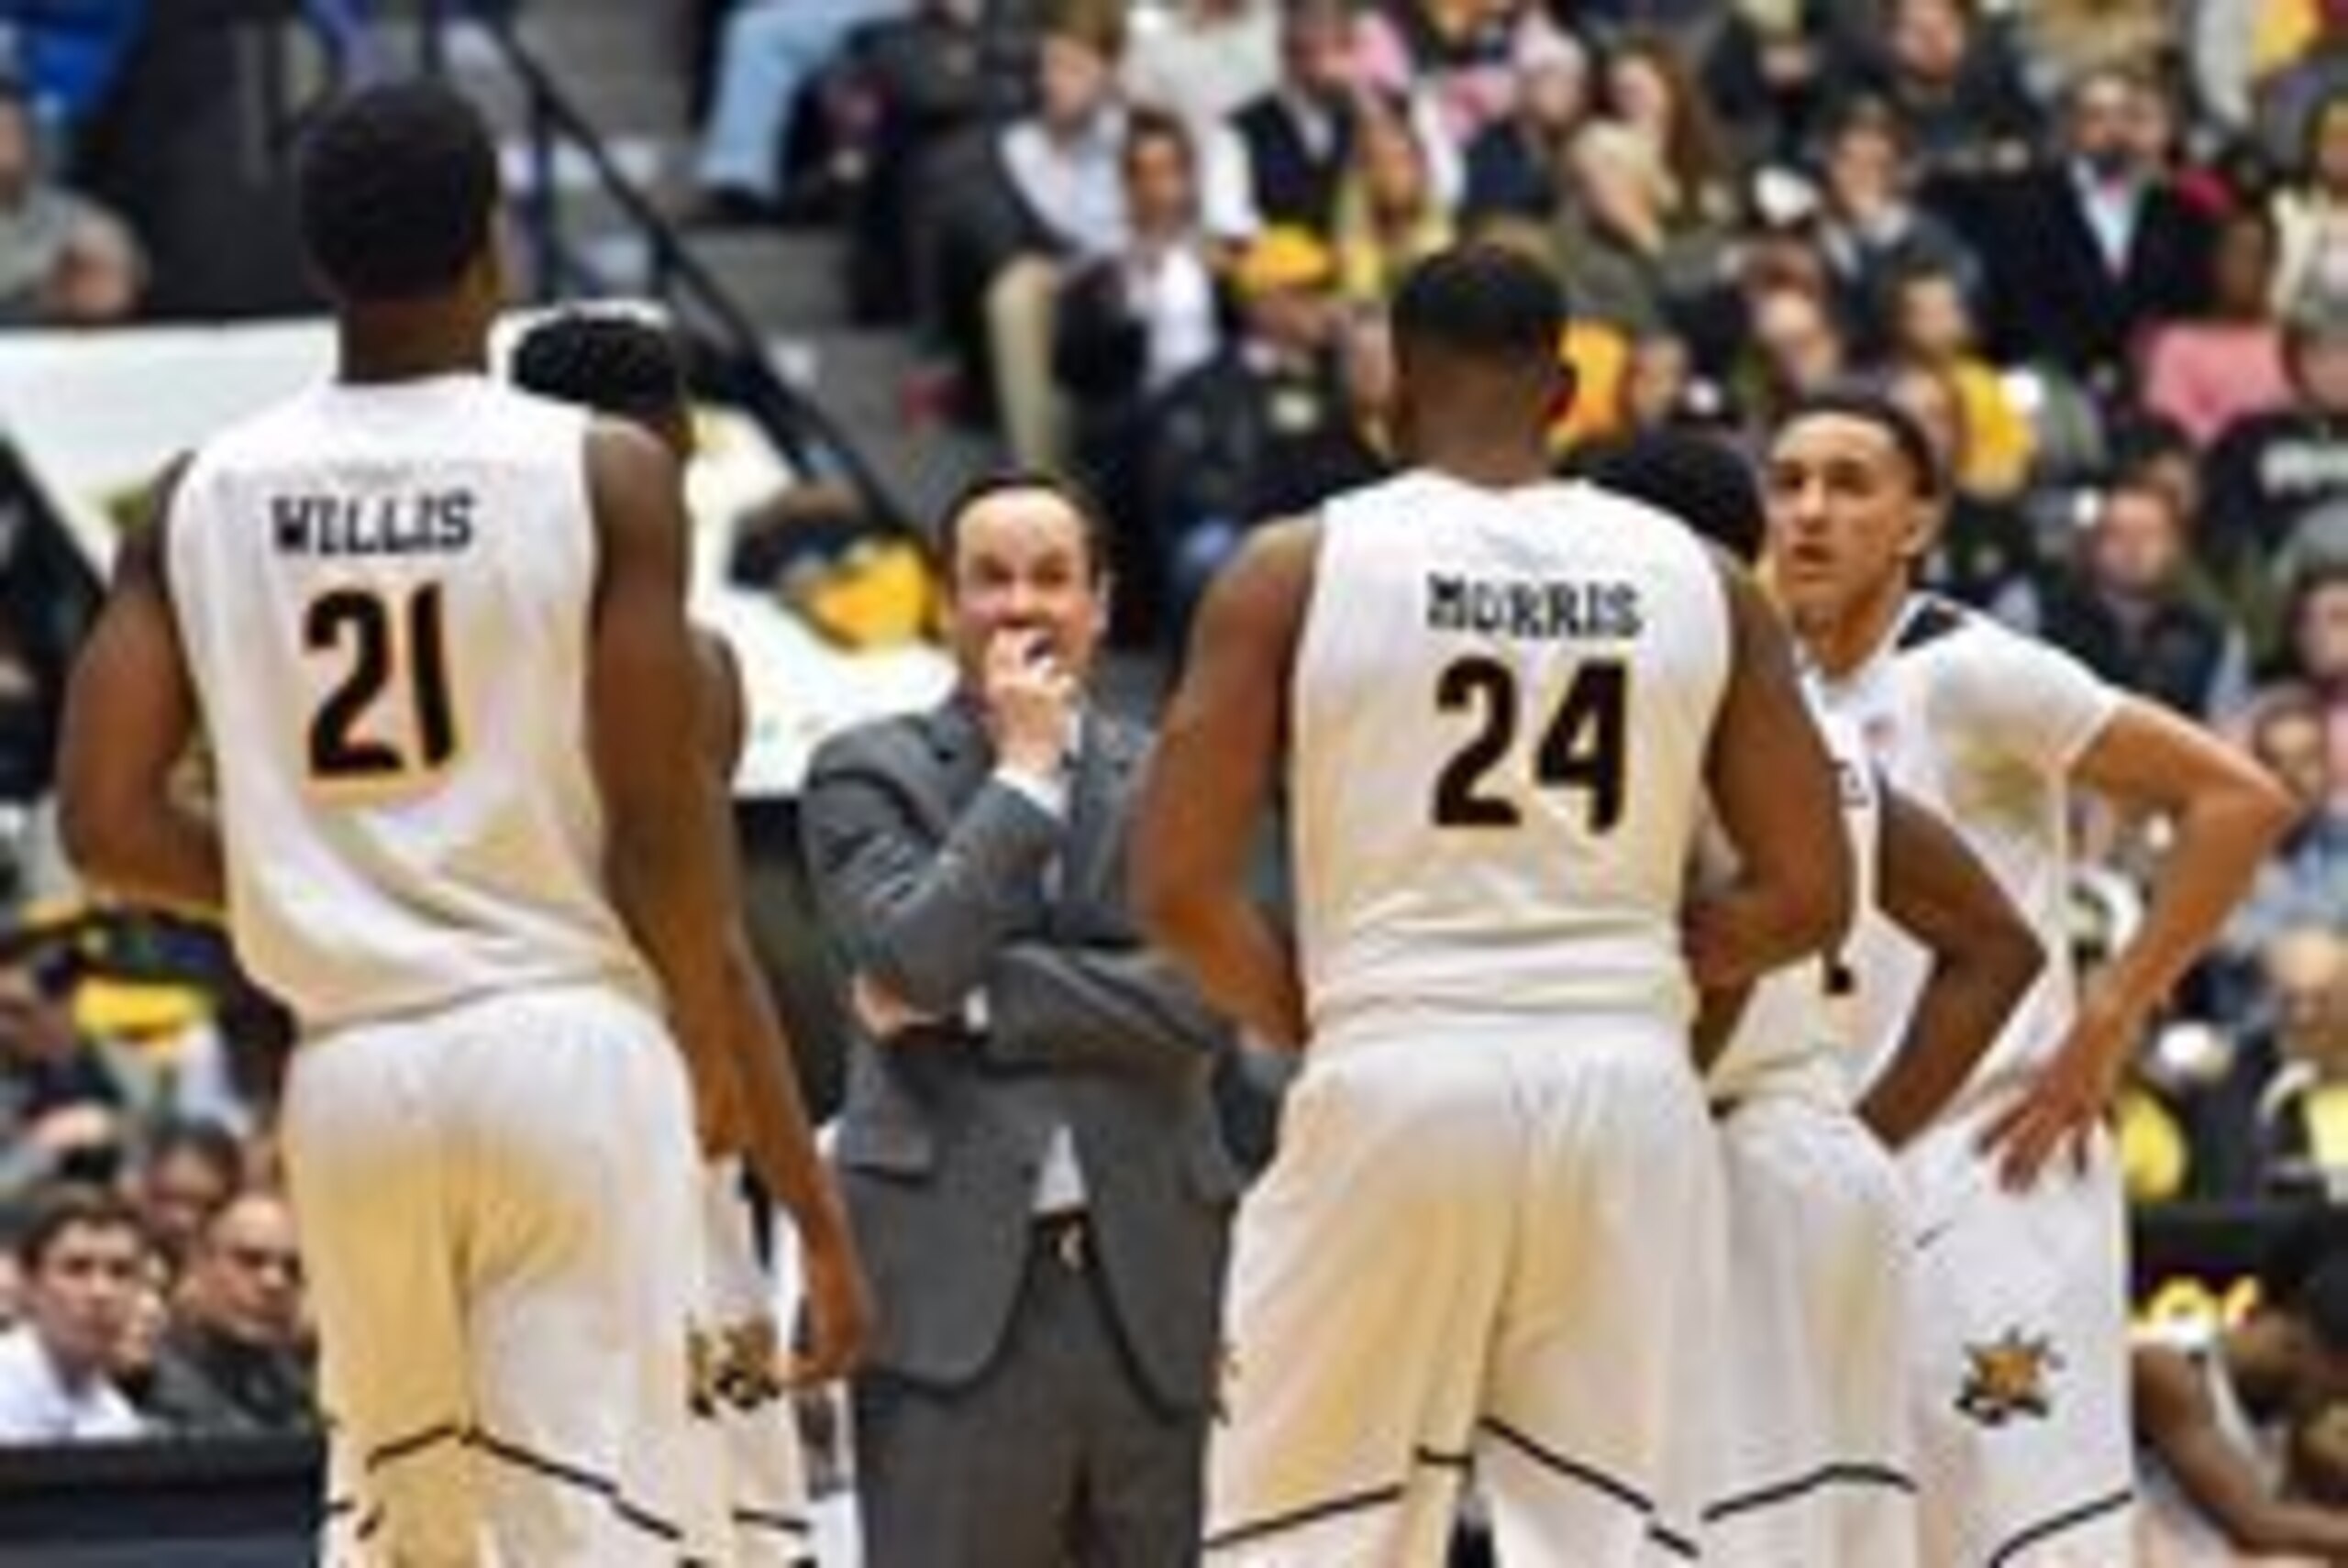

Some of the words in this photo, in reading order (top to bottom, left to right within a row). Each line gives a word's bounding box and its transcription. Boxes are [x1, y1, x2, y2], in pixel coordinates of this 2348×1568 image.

[271, 489, 476, 555] WILLIS
[1426, 572, 1644, 639] MORRIS
[304, 580, 455, 777] 21
[1433, 653, 1628, 834] 24
